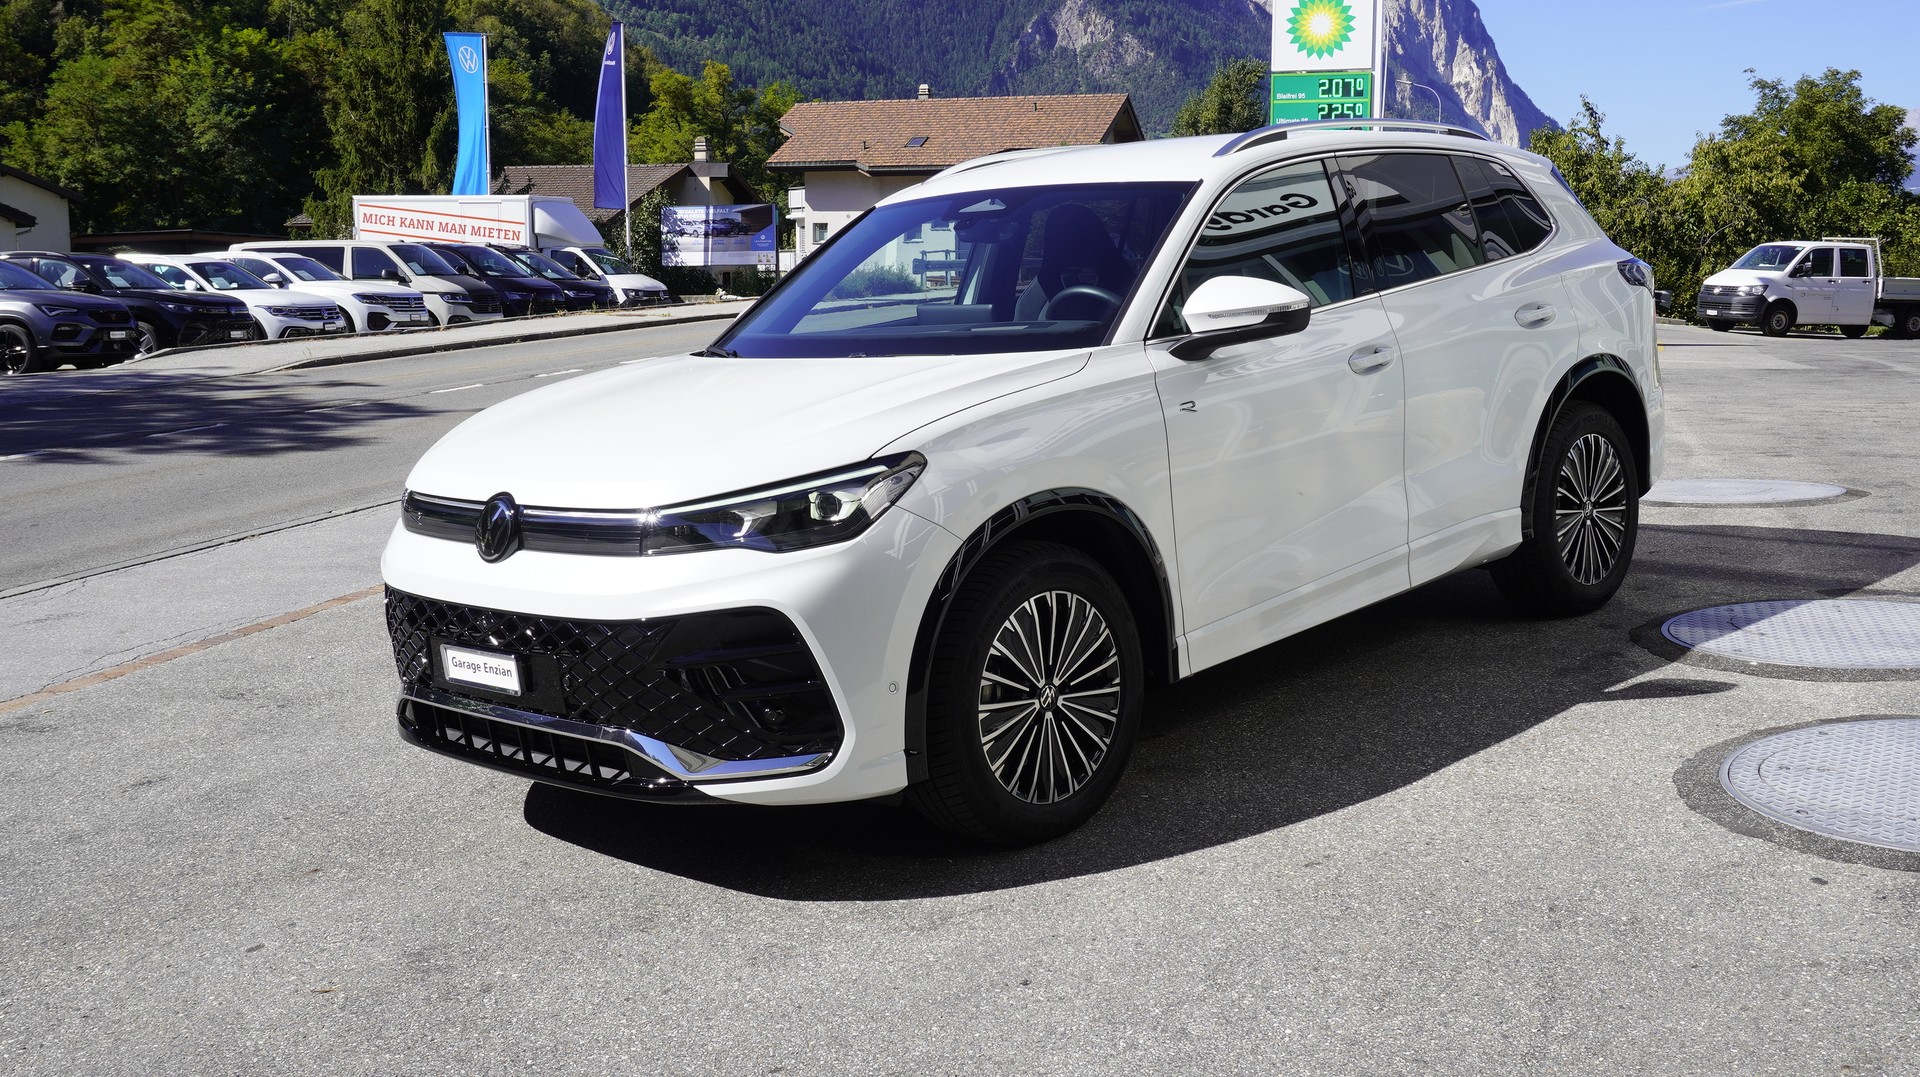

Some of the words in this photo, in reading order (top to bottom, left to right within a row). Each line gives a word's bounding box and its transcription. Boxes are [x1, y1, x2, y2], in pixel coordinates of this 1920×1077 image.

[1318, 103, 1363, 120] 2250
[362, 212, 396, 227] MICH
[399, 217, 435, 231] KANN
[438, 221, 467, 235] MAN
[470, 225, 522, 242] MIETEN
[451, 656, 482, 674] Garage
[483, 662, 513, 678] Enzian
